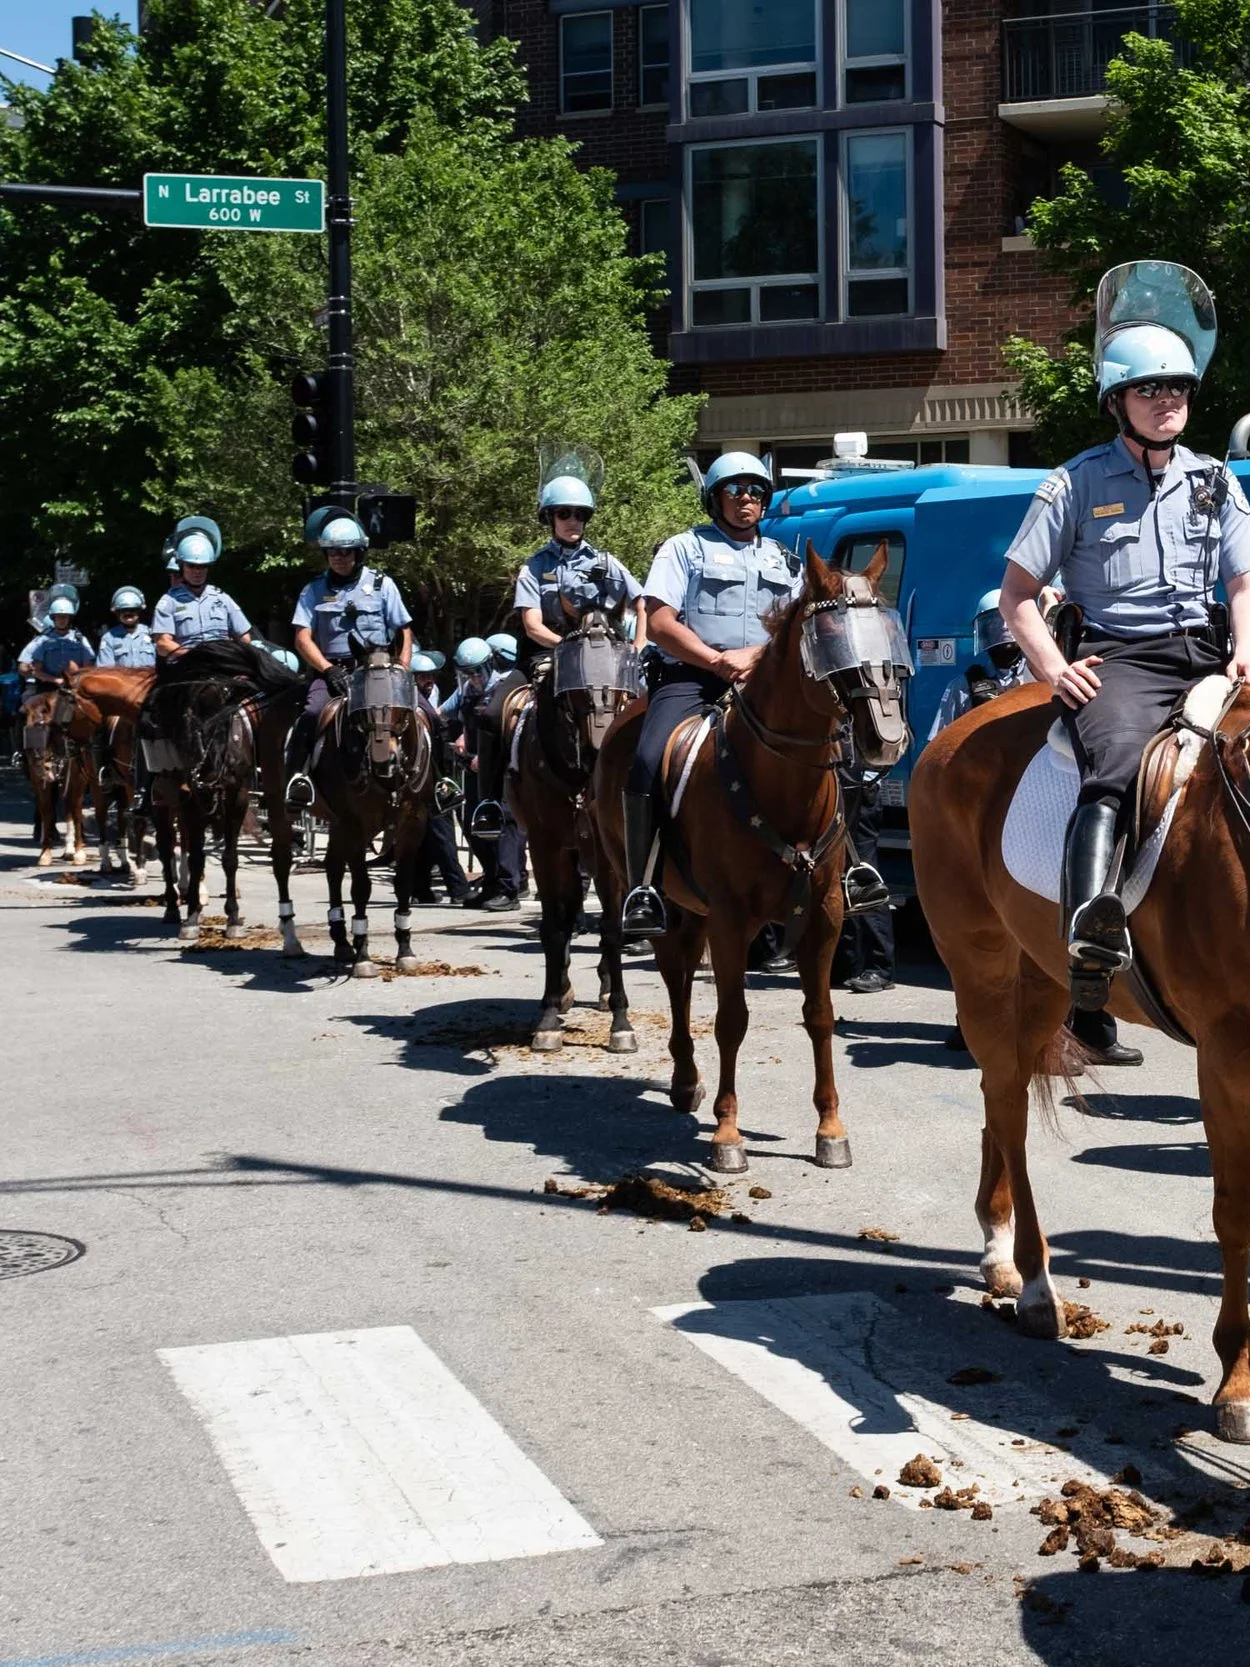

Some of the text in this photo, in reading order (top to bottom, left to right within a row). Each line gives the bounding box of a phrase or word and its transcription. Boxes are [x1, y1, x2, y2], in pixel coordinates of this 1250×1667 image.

[158, 182, 310, 205] N Larrabee St
[209, 208, 262, 222] 600 W
